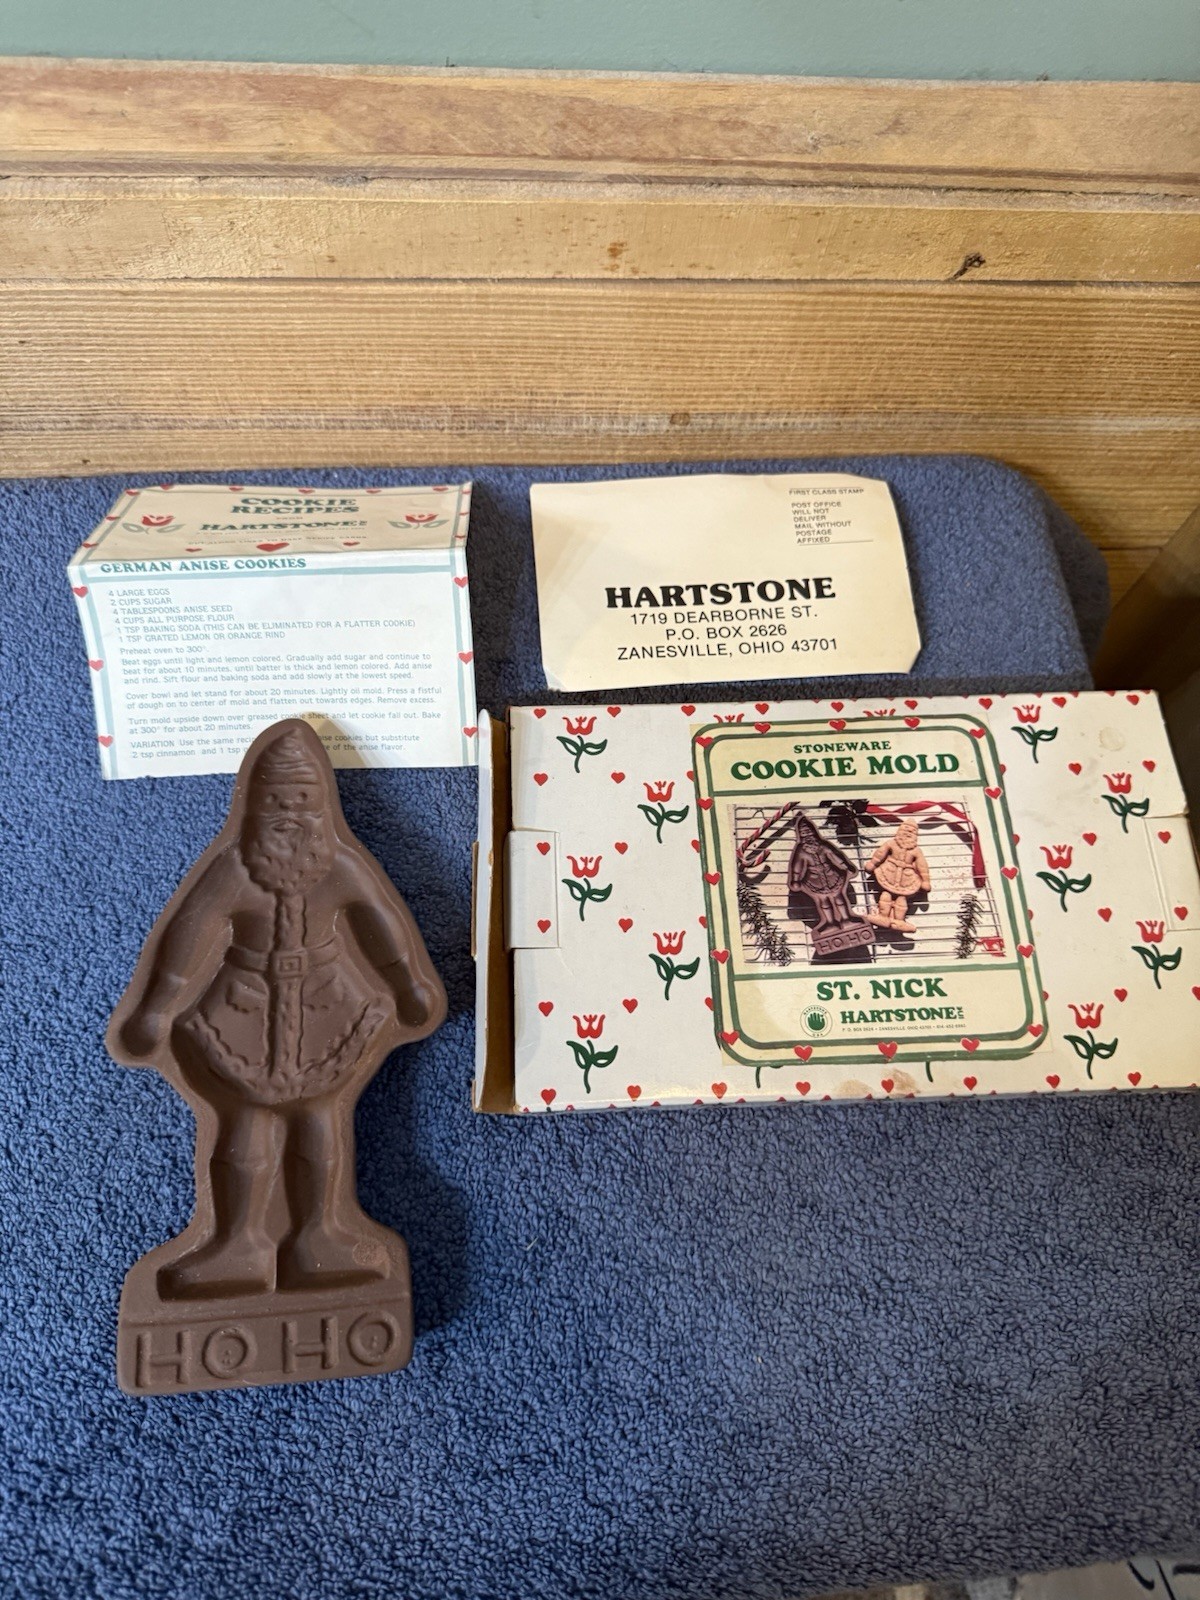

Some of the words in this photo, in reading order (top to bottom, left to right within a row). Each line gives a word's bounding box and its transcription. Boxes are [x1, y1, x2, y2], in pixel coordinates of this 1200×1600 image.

[231, 506, 359, 514] RECIPES
[201, 520, 357, 530] HARTSTONE
[101, 561, 172, 573] GERMAN
[179, 560, 229, 571] ANISE
[235, 558, 307, 570] COOKIES
[605, 577, 836, 608] HARTSTONE
[120, 607, 181, 615] TABLESPOONS
[631, 613, 667, 625] 1719
[674, 607, 784, 623] DEARBORNE
[792, 606, 818, 618] ST.
[203, 624, 225, 633] (THIS
[383, 620, 415, 629] COOKIE)
[666, 628, 699, 640] P.O.
[707, 626, 743, 639] BOX
[750, 624, 787, 637] 2626
[618, 643, 732, 660] ZANESVILLE,
[739, 641, 784, 654] OHIO
[792, 638, 836, 651] 43701
[794, 741, 891, 754] STONEWARE
[731, 756, 856, 780] COOKIE
[867, 754, 959, 775] MOLD
[816, 981, 860, 1000] ST.
[870, 977, 948, 998] NICK
[840, 1006, 957, 1024] HARTSTONE
[136, 1326, 256, 1388] HO
[282, 1311, 400, 1373] HO
